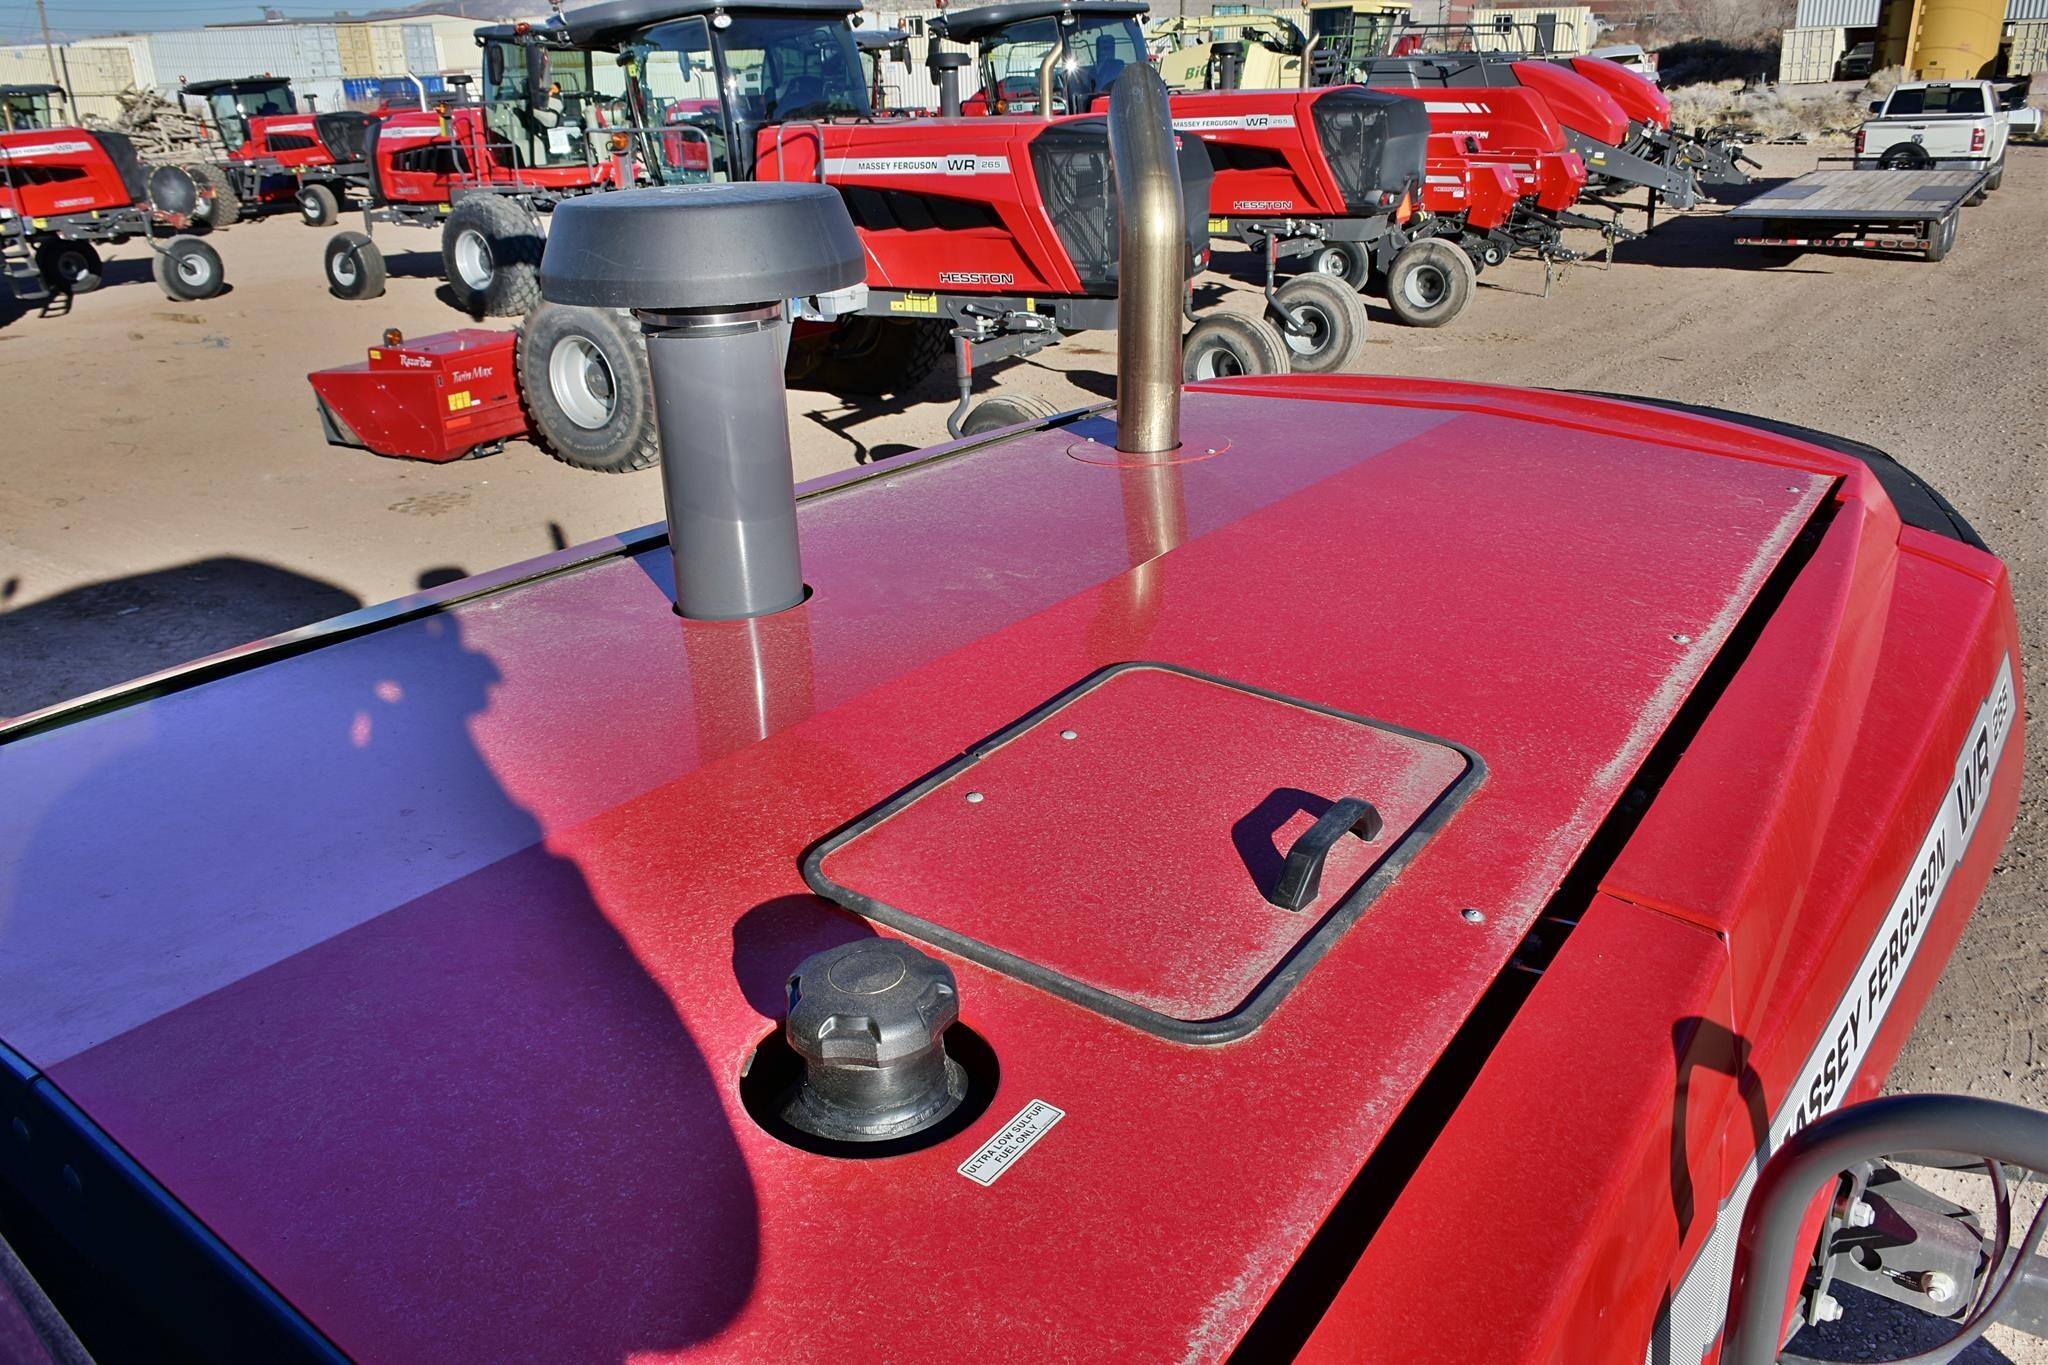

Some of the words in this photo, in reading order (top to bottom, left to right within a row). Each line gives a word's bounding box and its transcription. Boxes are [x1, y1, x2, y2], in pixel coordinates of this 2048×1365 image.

[1246, 117, 1268, 127] WR
[858, 161, 891, 170] MASSEY
[893, 160, 938, 170] FERGUSON
[947, 159, 976, 171] WR
[981, 161, 1001, 169] 265
[1233, 200, 1293, 210] HESSTON
[939, 272, 1014, 284] HESSTON
[1784, 996, 1862, 1143] ASSEY
[1868, 829, 1947, 1022] FERGUSON
[1956, 722, 1989, 838] WR
[1992, 680, 2008, 745] 265
[966, 1148, 997, 1174] ULTRA
[996, 1132, 1014, 1150] LOW
[1012, 1105, 1045, 1133] SULFUR
[994, 1145, 1019, 1163] FUEL
[1015, 1124, 1038, 1144] ONLY
